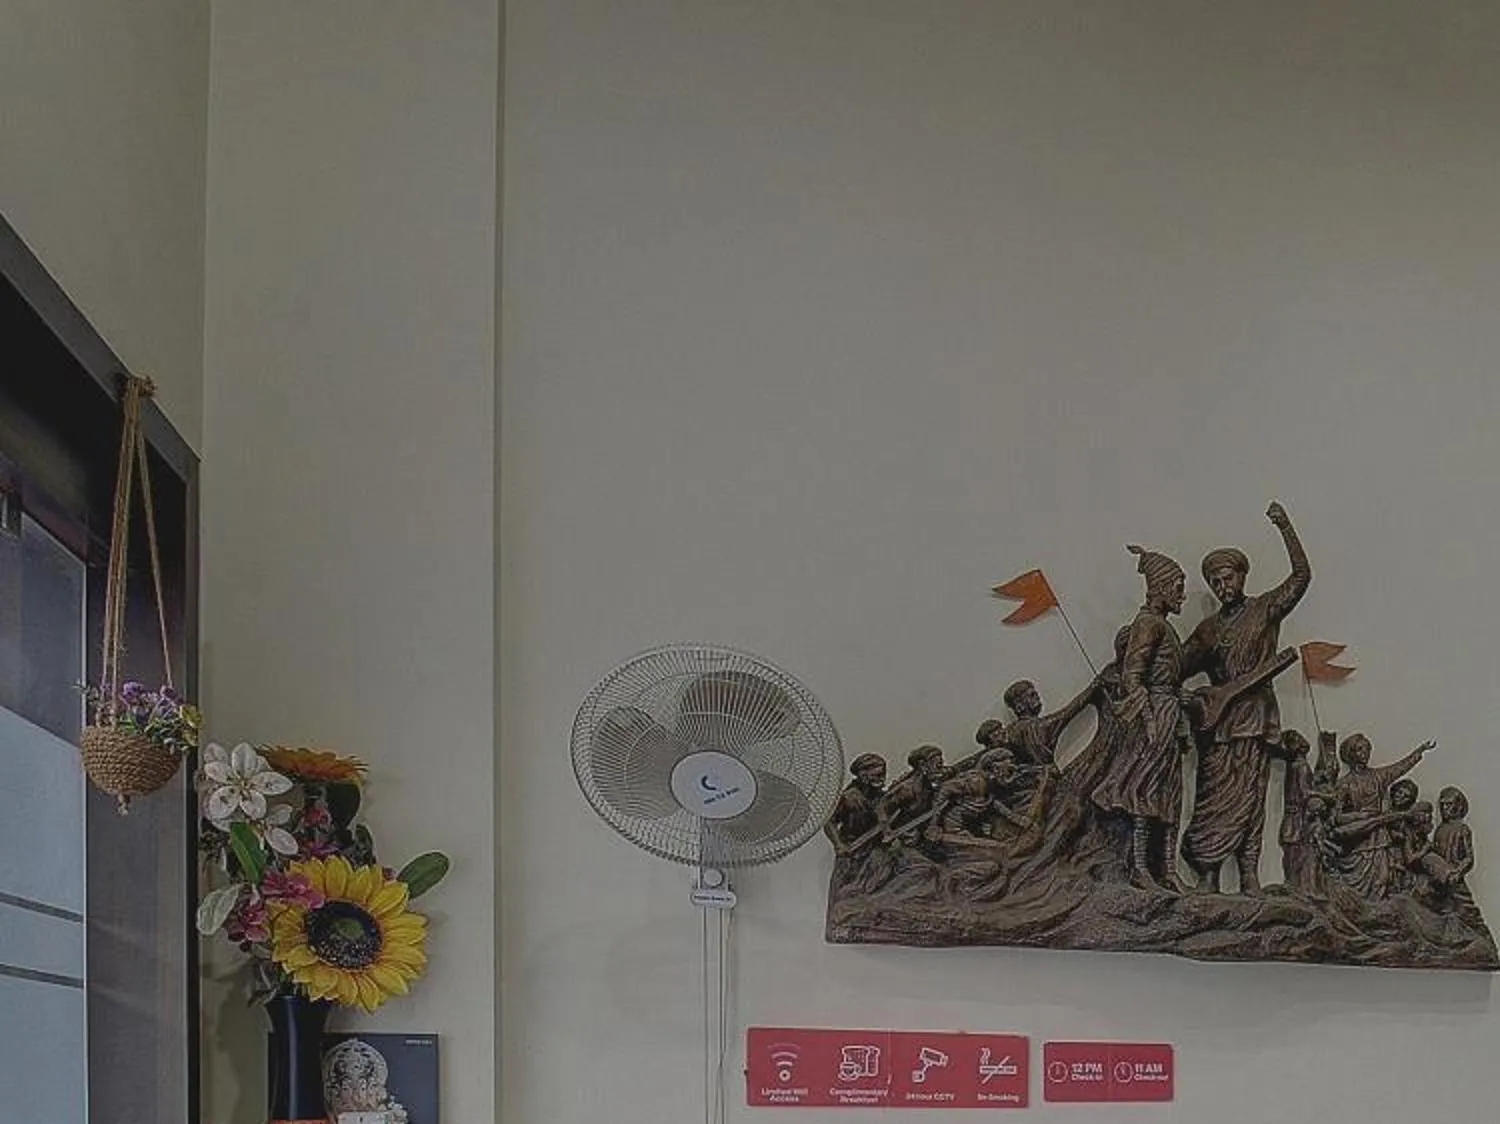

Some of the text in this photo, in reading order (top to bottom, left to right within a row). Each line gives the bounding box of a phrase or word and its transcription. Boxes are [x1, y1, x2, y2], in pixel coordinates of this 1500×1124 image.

[1071, 1063, 1103, 1072] 12 PM
[1145, 1064, 1162, 1072] AM
